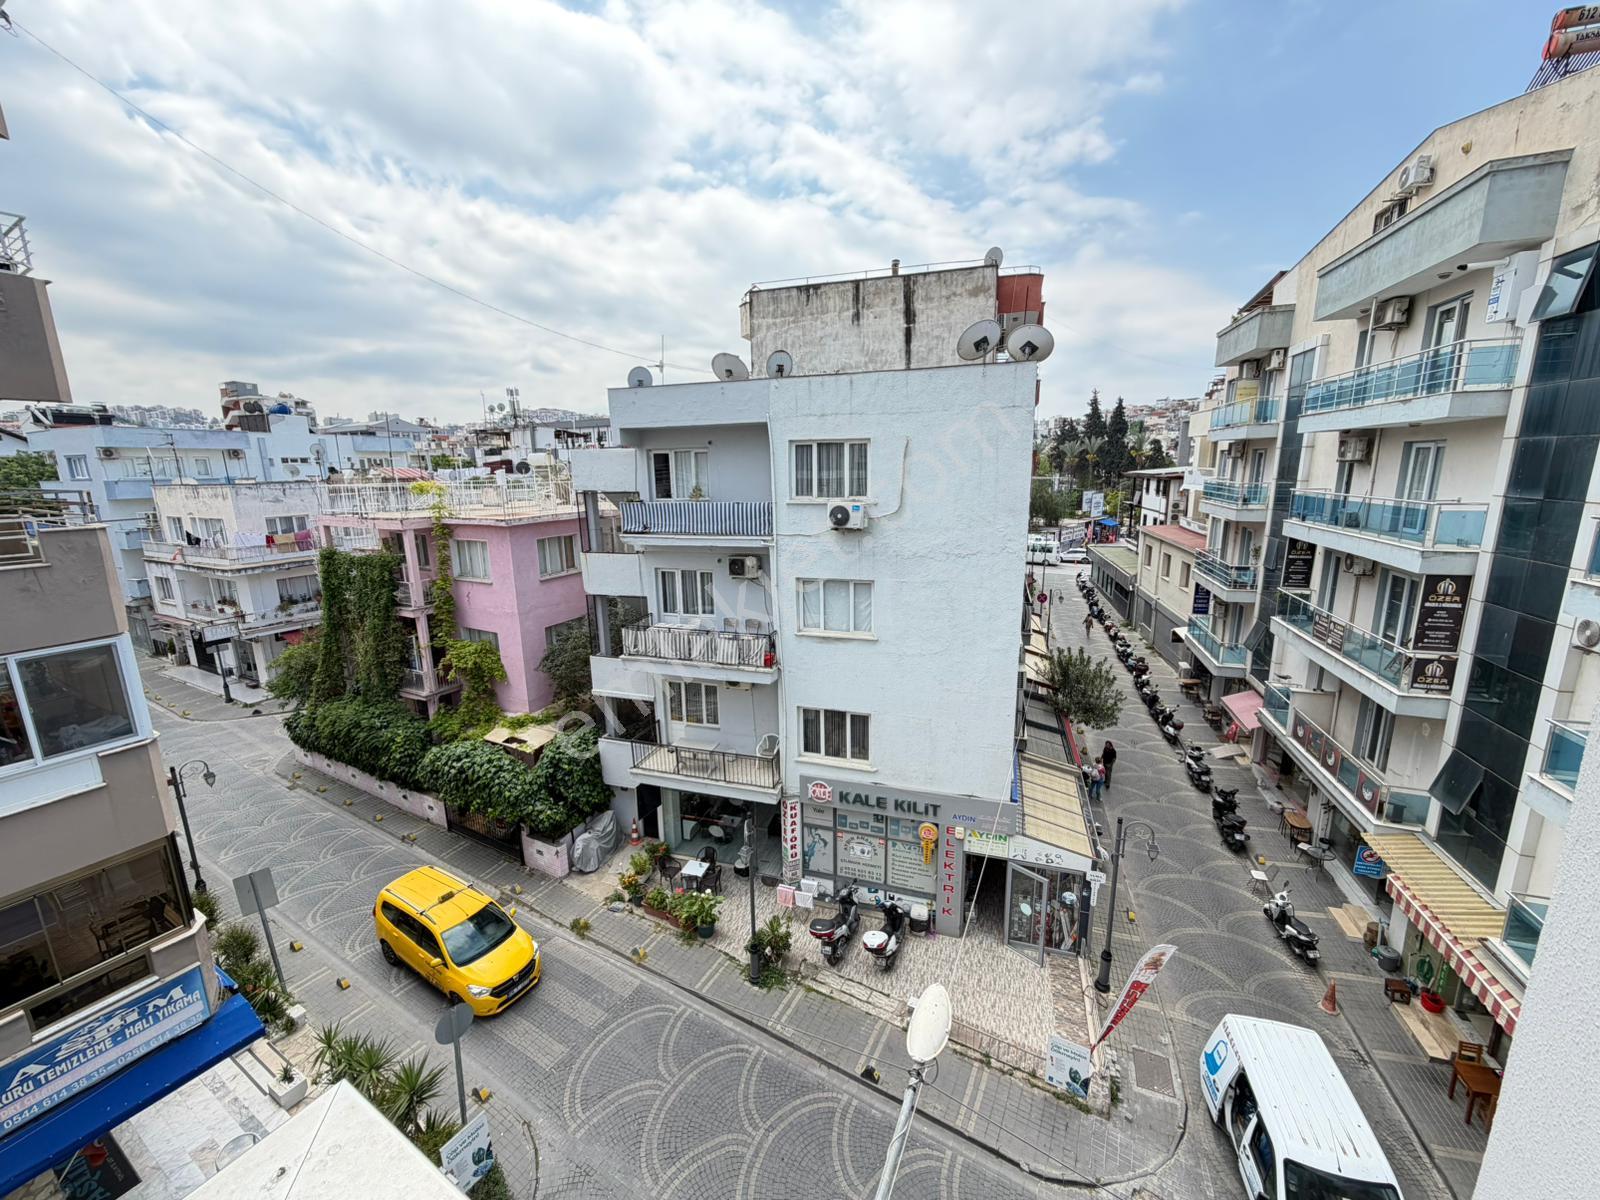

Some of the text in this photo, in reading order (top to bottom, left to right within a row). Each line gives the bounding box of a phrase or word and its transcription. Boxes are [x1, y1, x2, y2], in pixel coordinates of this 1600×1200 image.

[839, 791, 888, 810] KALE
[952, 814, 976, 823] AYDIN
[0, 1080, 35, 1107] URU
[125, 1014, 154, 1039] HALI
[156, 990, 201, 1020] YIKAMA
[4, 1105, 39, 1129] 0544
[71, 1078, 87, 1092] 38
